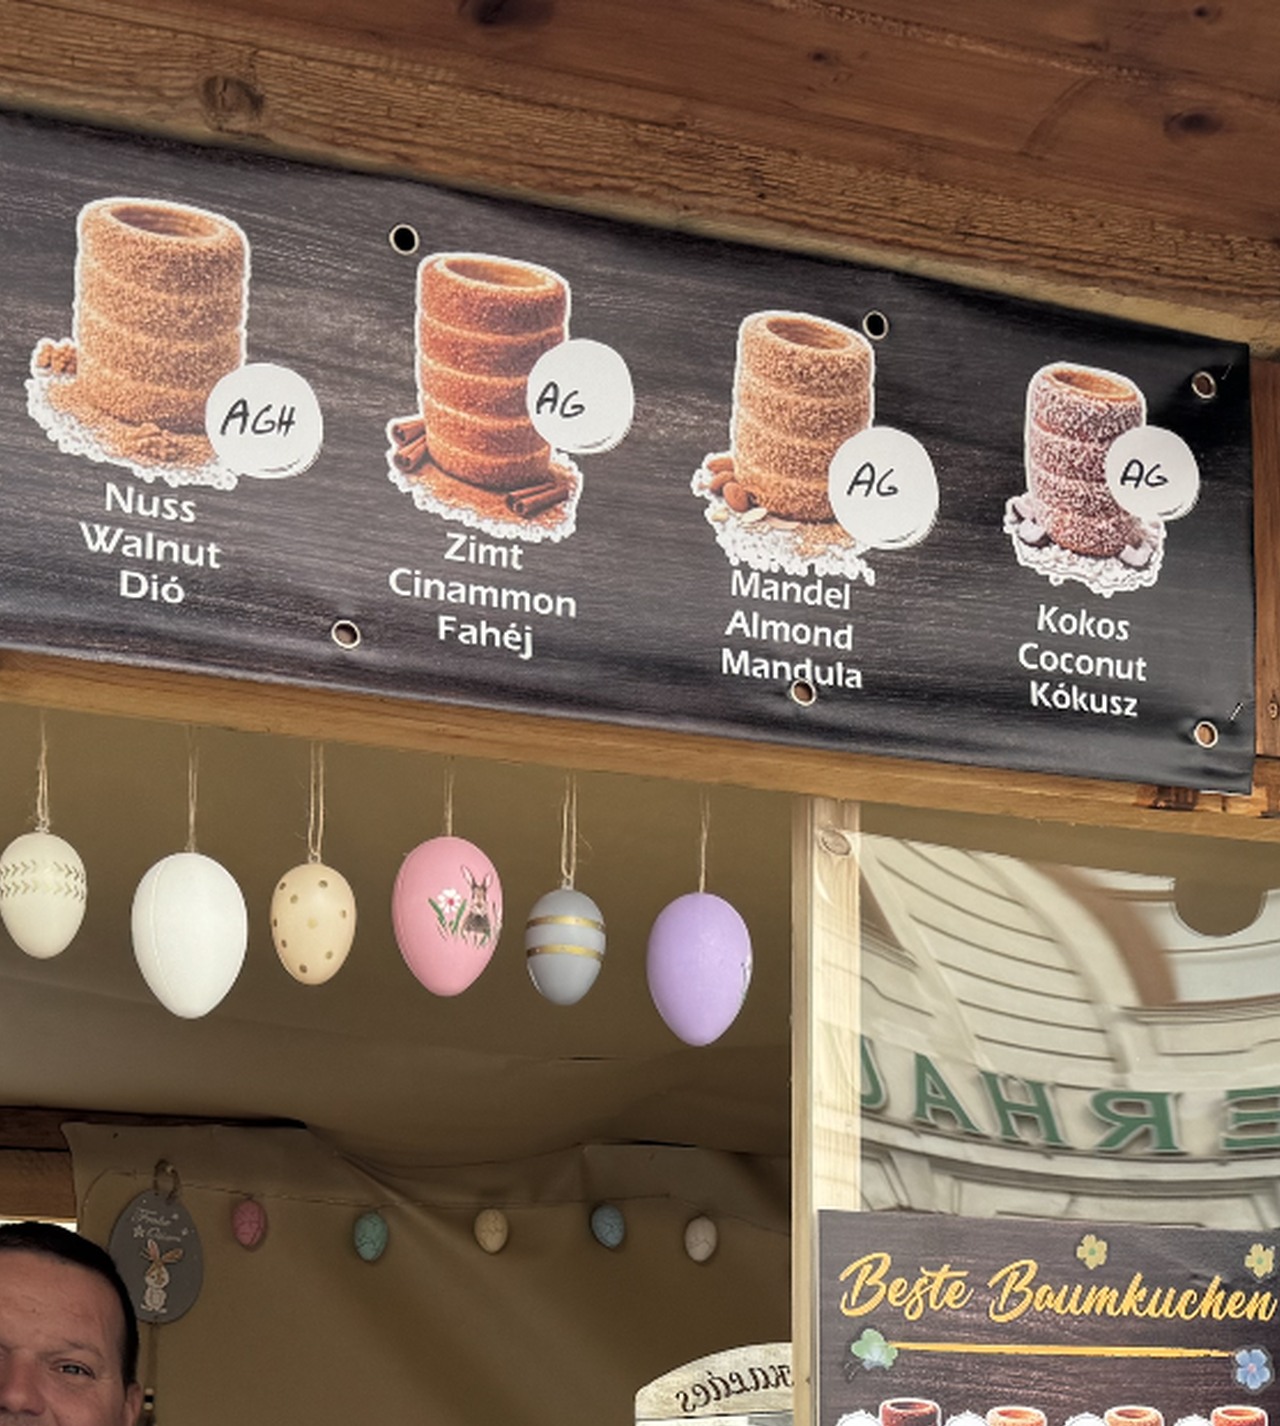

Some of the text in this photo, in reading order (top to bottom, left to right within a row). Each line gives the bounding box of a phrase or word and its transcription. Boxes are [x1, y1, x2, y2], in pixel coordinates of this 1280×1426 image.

[221, 399, 296, 438] AGH
[536, 382, 585, 418] AG
[846, 462, 899, 499] AG
[1120, 461, 1168, 488] AG
[105, 483, 197, 523] Nuss
[79, 521, 222, 569] Walnut
[444, 533, 523, 570] Zimt
[119, 570, 185, 604] Dió
[389, 568, 577, 618] Cinammon
[730, 570, 851, 610] Mandel
[438, 615, 534, 660] Fahéj
[725, 610, 854, 651] Almond
[1036, 604, 1130, 641] Kokos
[721, 647, 863, 690] Mandula
[1018, 642, 1147, 682] Coconut
[1030, 681, 1138, 717] Kókusz
[839, 1252, 1278, 1323] Beste Baumkuchen
